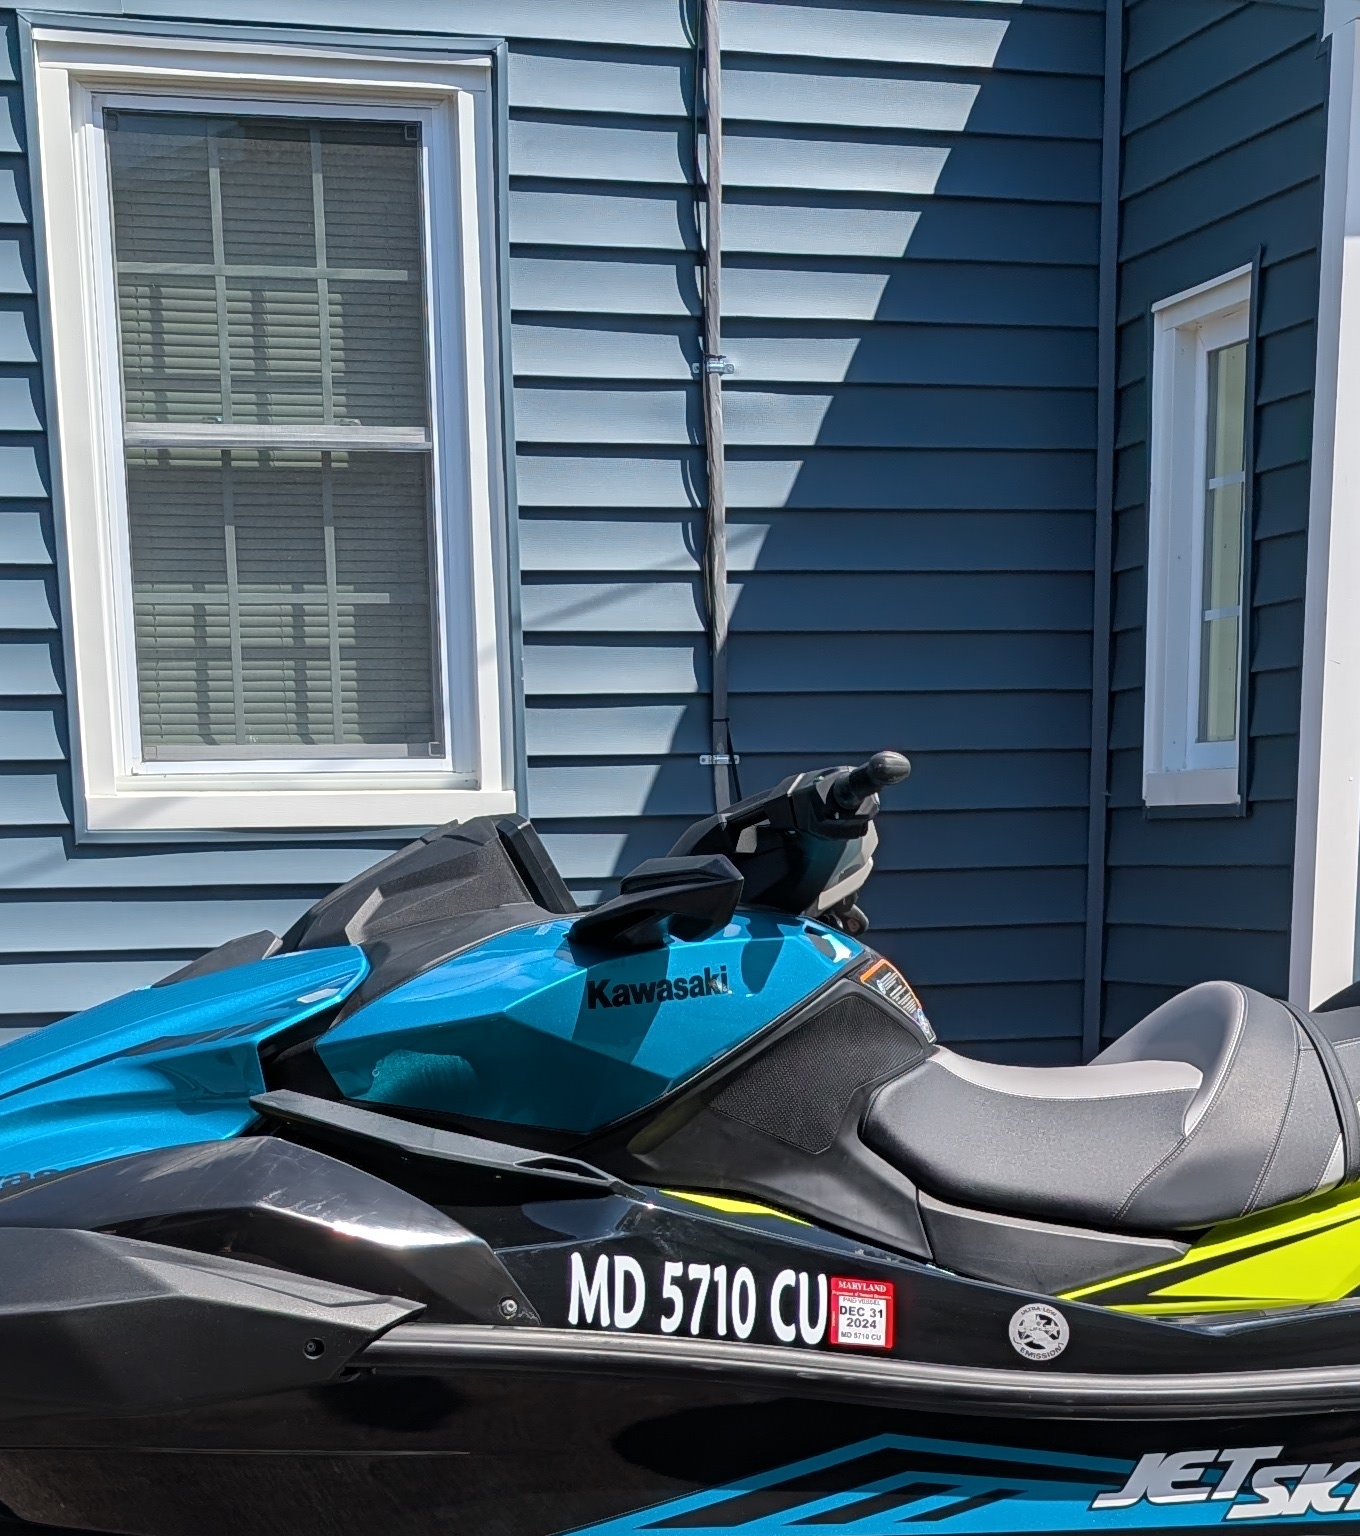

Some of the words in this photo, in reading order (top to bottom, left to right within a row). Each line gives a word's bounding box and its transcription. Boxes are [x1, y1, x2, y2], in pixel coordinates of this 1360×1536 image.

[586, 964, 729, 1010] Kawasaki
[837, 1280, 887, 1292] MARYLAND
[567, 1251, 646, 1329] MD
[660, 1260, 757, 1339] 5710
[770, 1268, 828, 1346] CU
[839, 1305, 865, 1317] DEC
[869, 1307, 883, 1319] 31
[845, 1317, 877, 1329] 2024
[840, 1331, 852, 1339] MD
[870, 1333, 882, 1341] CU
[1091, 1445, 1285, 1510] JET
